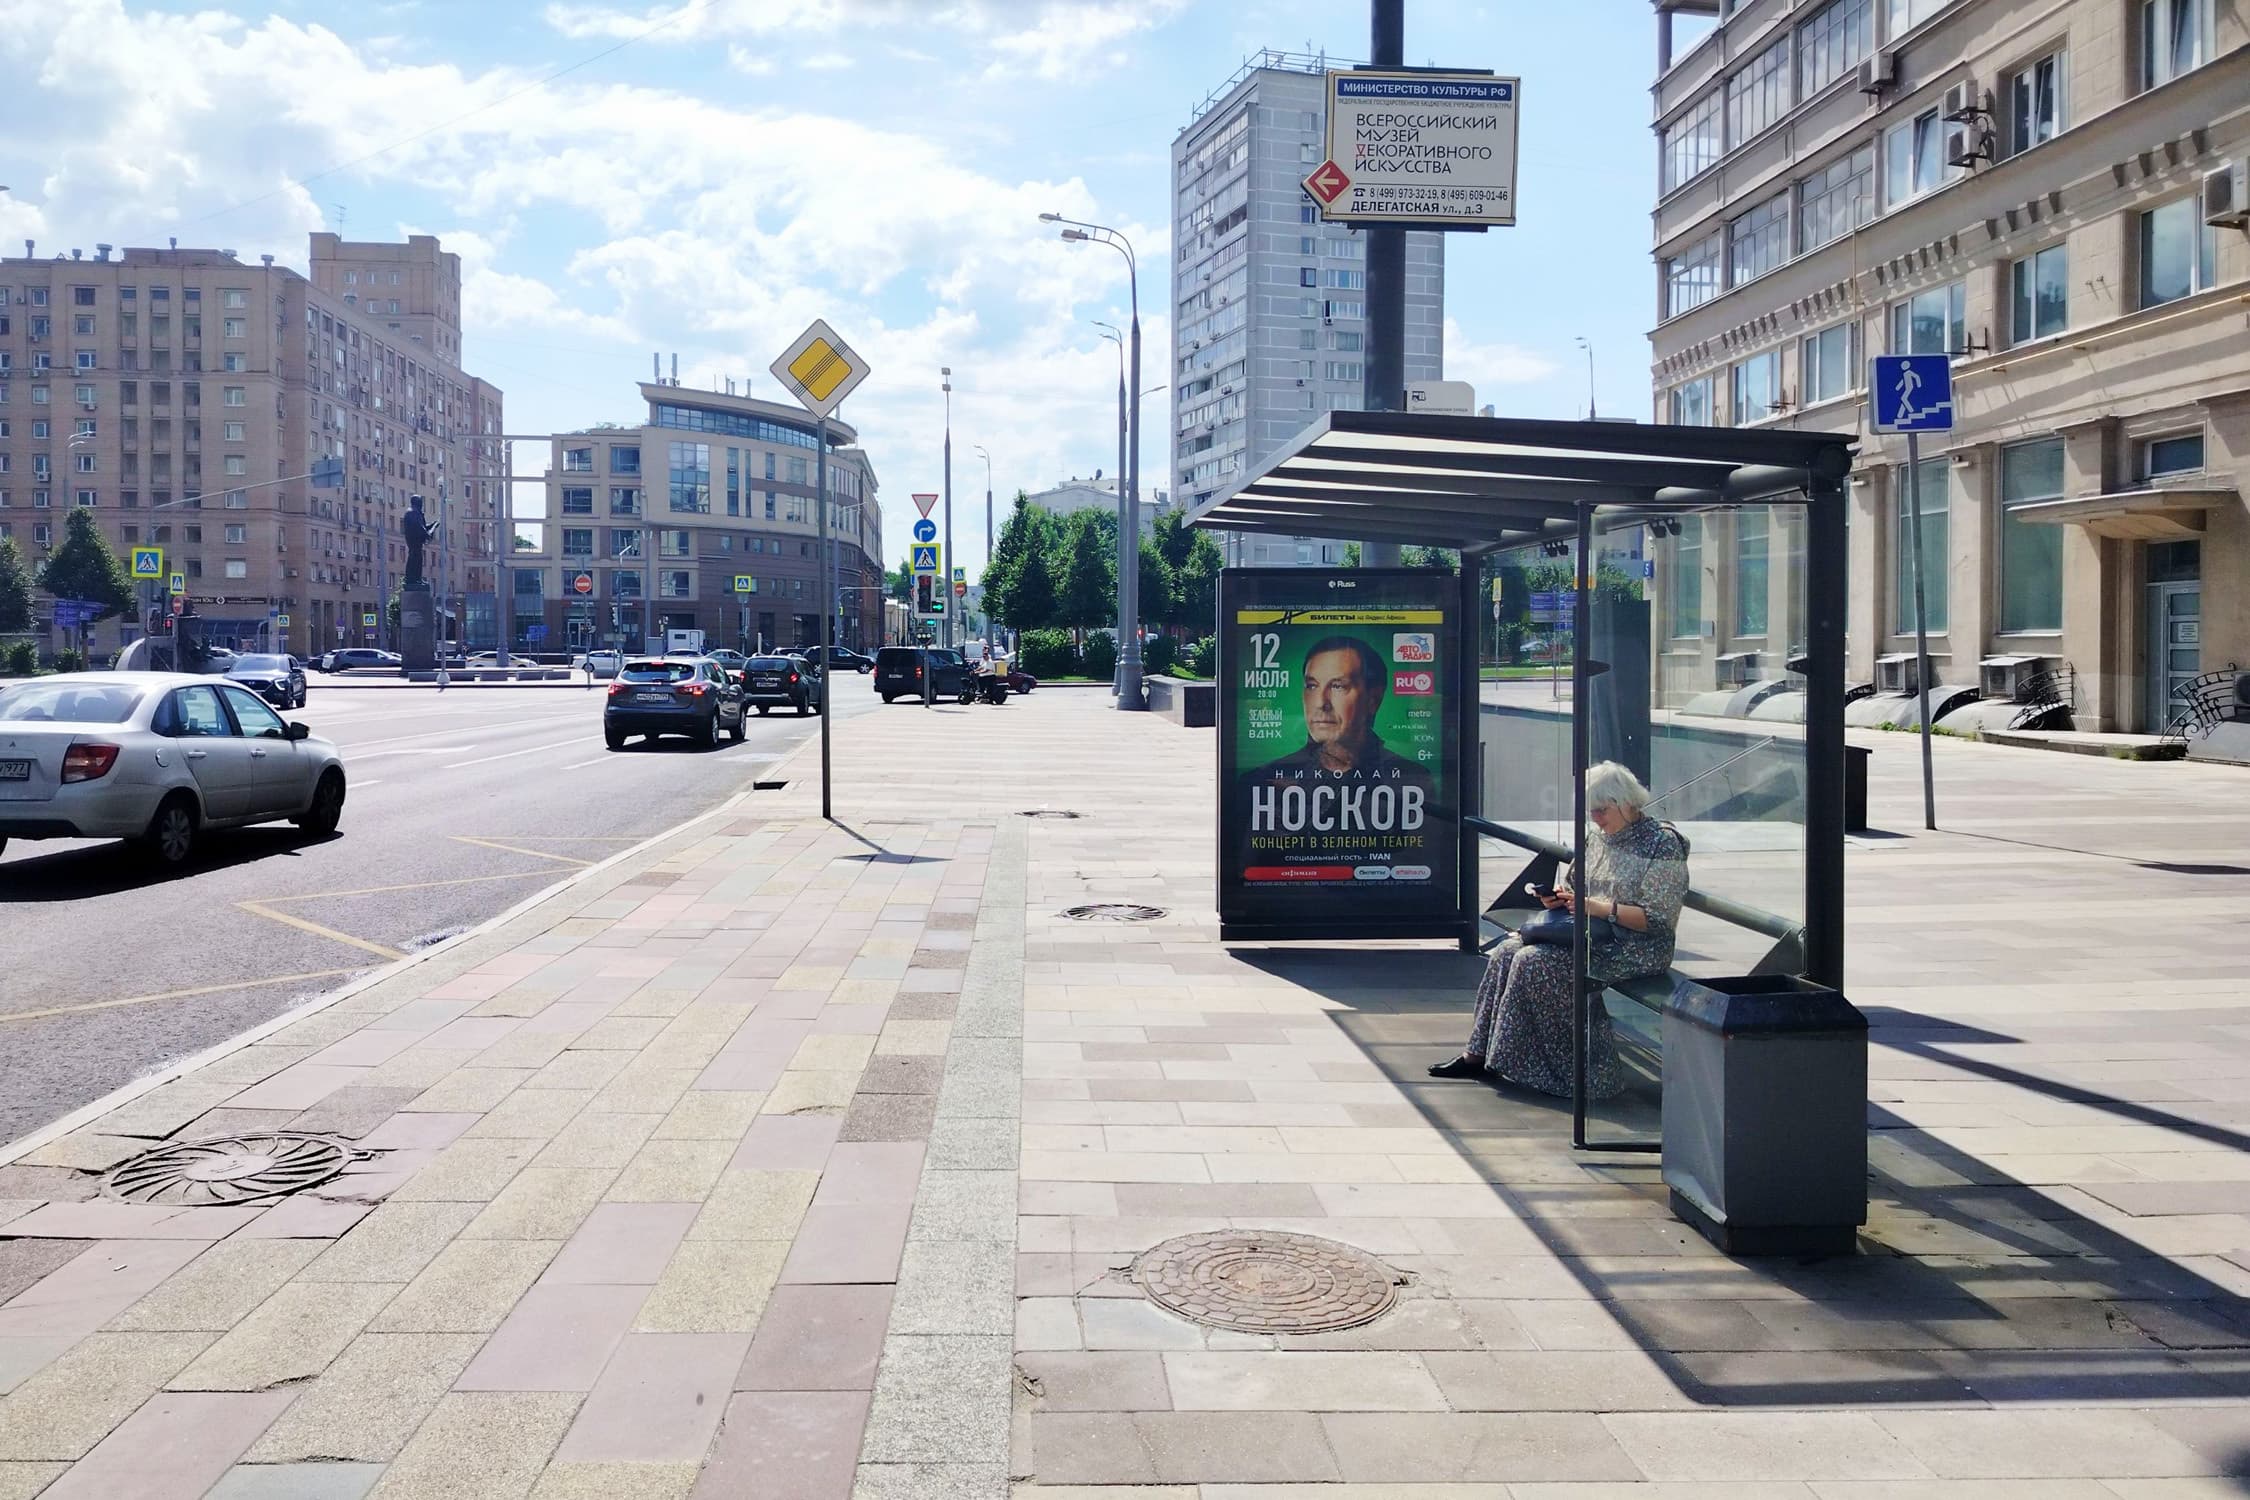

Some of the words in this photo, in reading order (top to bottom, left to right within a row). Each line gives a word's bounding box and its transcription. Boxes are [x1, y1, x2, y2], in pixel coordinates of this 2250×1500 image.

[1343, 82, 1429, 95] МИНИСТЕРСТВО
[1432, 85, 1487, 97] КУЛЬТУРЫ
[1490, 87, 1507, 97] РФ
[1356, 113, 1497, 130] ВСЕРОССИЙСКИЙ
[1356, 128, 1419, 143] МУЗЕЙ
[1355, 144, 1492, 160] ДЕКОРАТИВНОГО
[1355, 159, 1452, 174] ИСКУССТВА
[1369, 188, 1375, 198] 8
[1376, 187, 1397, 199] (499)
[1398, 188, 1439, 200] 973-32-19,
[1441, 188, 1446, 198] 8
[1447, 188, 1468, 200] (495)
[1469, 189, 1508, 201] 609-01-46
[1350, 202, 1439, 213] ДЕЛЕГАТСКАЯ
[1249, 632, 1280, 668] 12
[1244, 670, 1290, 688] ИЮЛЯ
[1395, 676, 1414, 688] RU
[1257, 690, 1277, 698] 20:00
[1248, 729, 1282, 738] ВДНХ
[1418, 749, 1433, 760] 6+
[7, 763, 25, 772] 977
[1275, 767, 1401, 779] НИКОЛАЙ
[1251, 784, 1425, 832] НОСКОВ
[1251, 836, 1306, 850] КОНЦЕРТ
[1310, 836, 1317, 848] В
[1322, 836, 1377, 848] ЗЕЛЕНОМ
[1382, 835, 1424, 848] ТЕАТРЕ
[1284, 854, 1339, 862] специальный
[1369, 853, 1391, 861] IVAN
